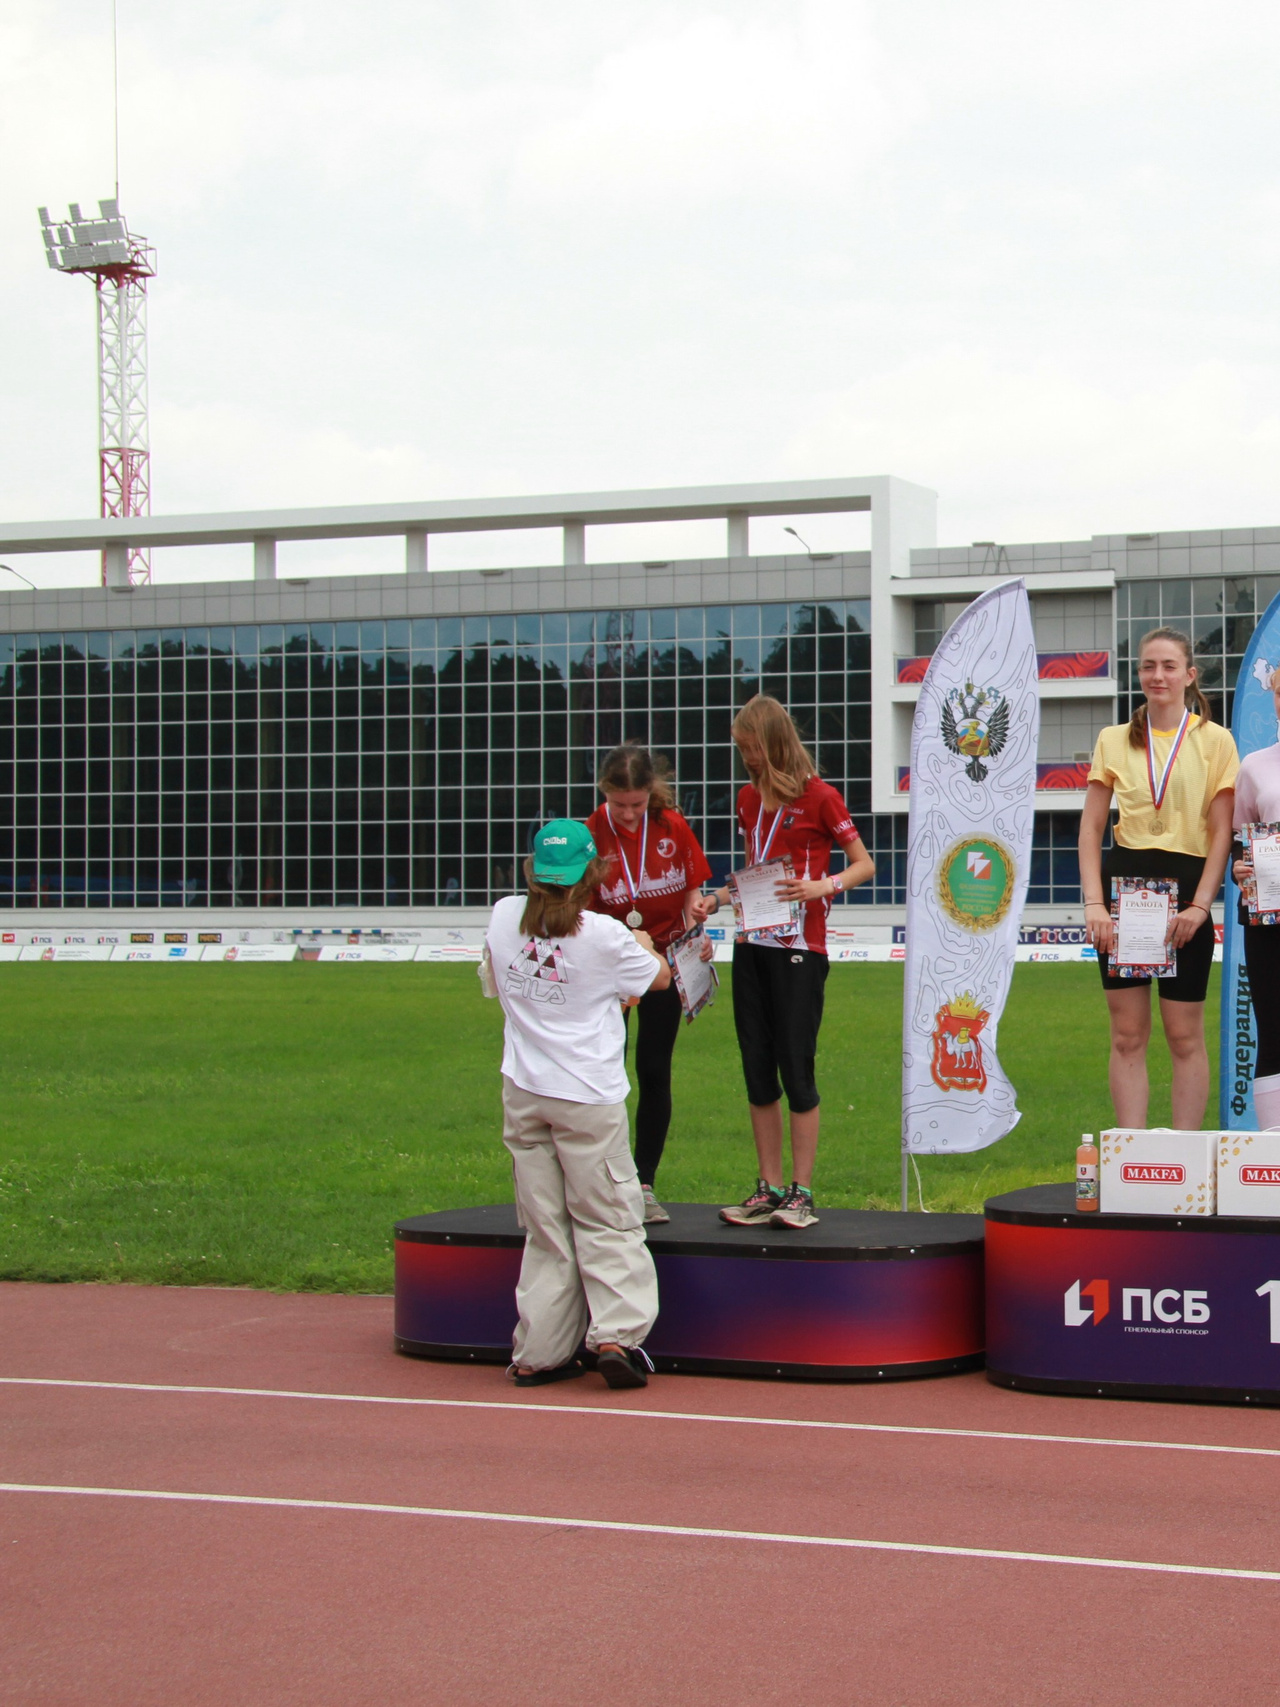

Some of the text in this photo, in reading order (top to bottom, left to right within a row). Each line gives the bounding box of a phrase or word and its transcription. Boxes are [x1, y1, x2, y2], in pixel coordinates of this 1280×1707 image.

[1125, 900, 1163, 909] ГРАМОТА
[850, 950, 869, 958] ПСБ
[1040, 952, 1059, 960] ПСБ
[504, 971, 567, 1006] FILA
[1230, 963, 1256, 1117] Федерация
[1126, 1167, 1180, 1182] MAKFA
[1122, 1287, 1211, 1324] ПСБ
[1124, 1326, 1209, 1336] ГЕНЕРАЛЬНЫЙ СПОНСОР
